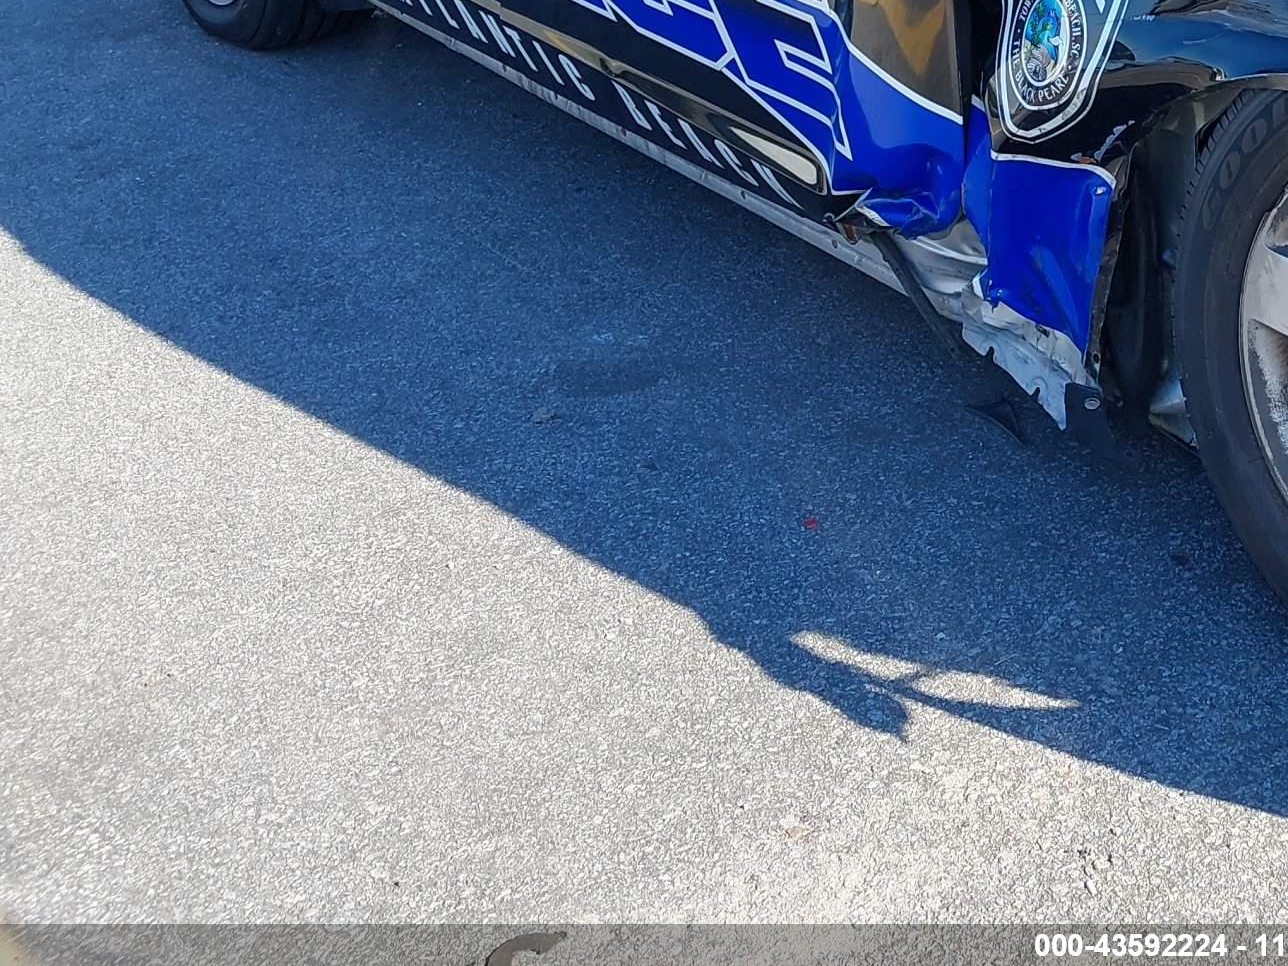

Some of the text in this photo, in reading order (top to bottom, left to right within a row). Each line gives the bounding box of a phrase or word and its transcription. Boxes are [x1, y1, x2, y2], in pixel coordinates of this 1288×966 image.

[1012, 40, 1069, 103] THE BLACK PEARL
[612, 80, 805, 210] BEACH
